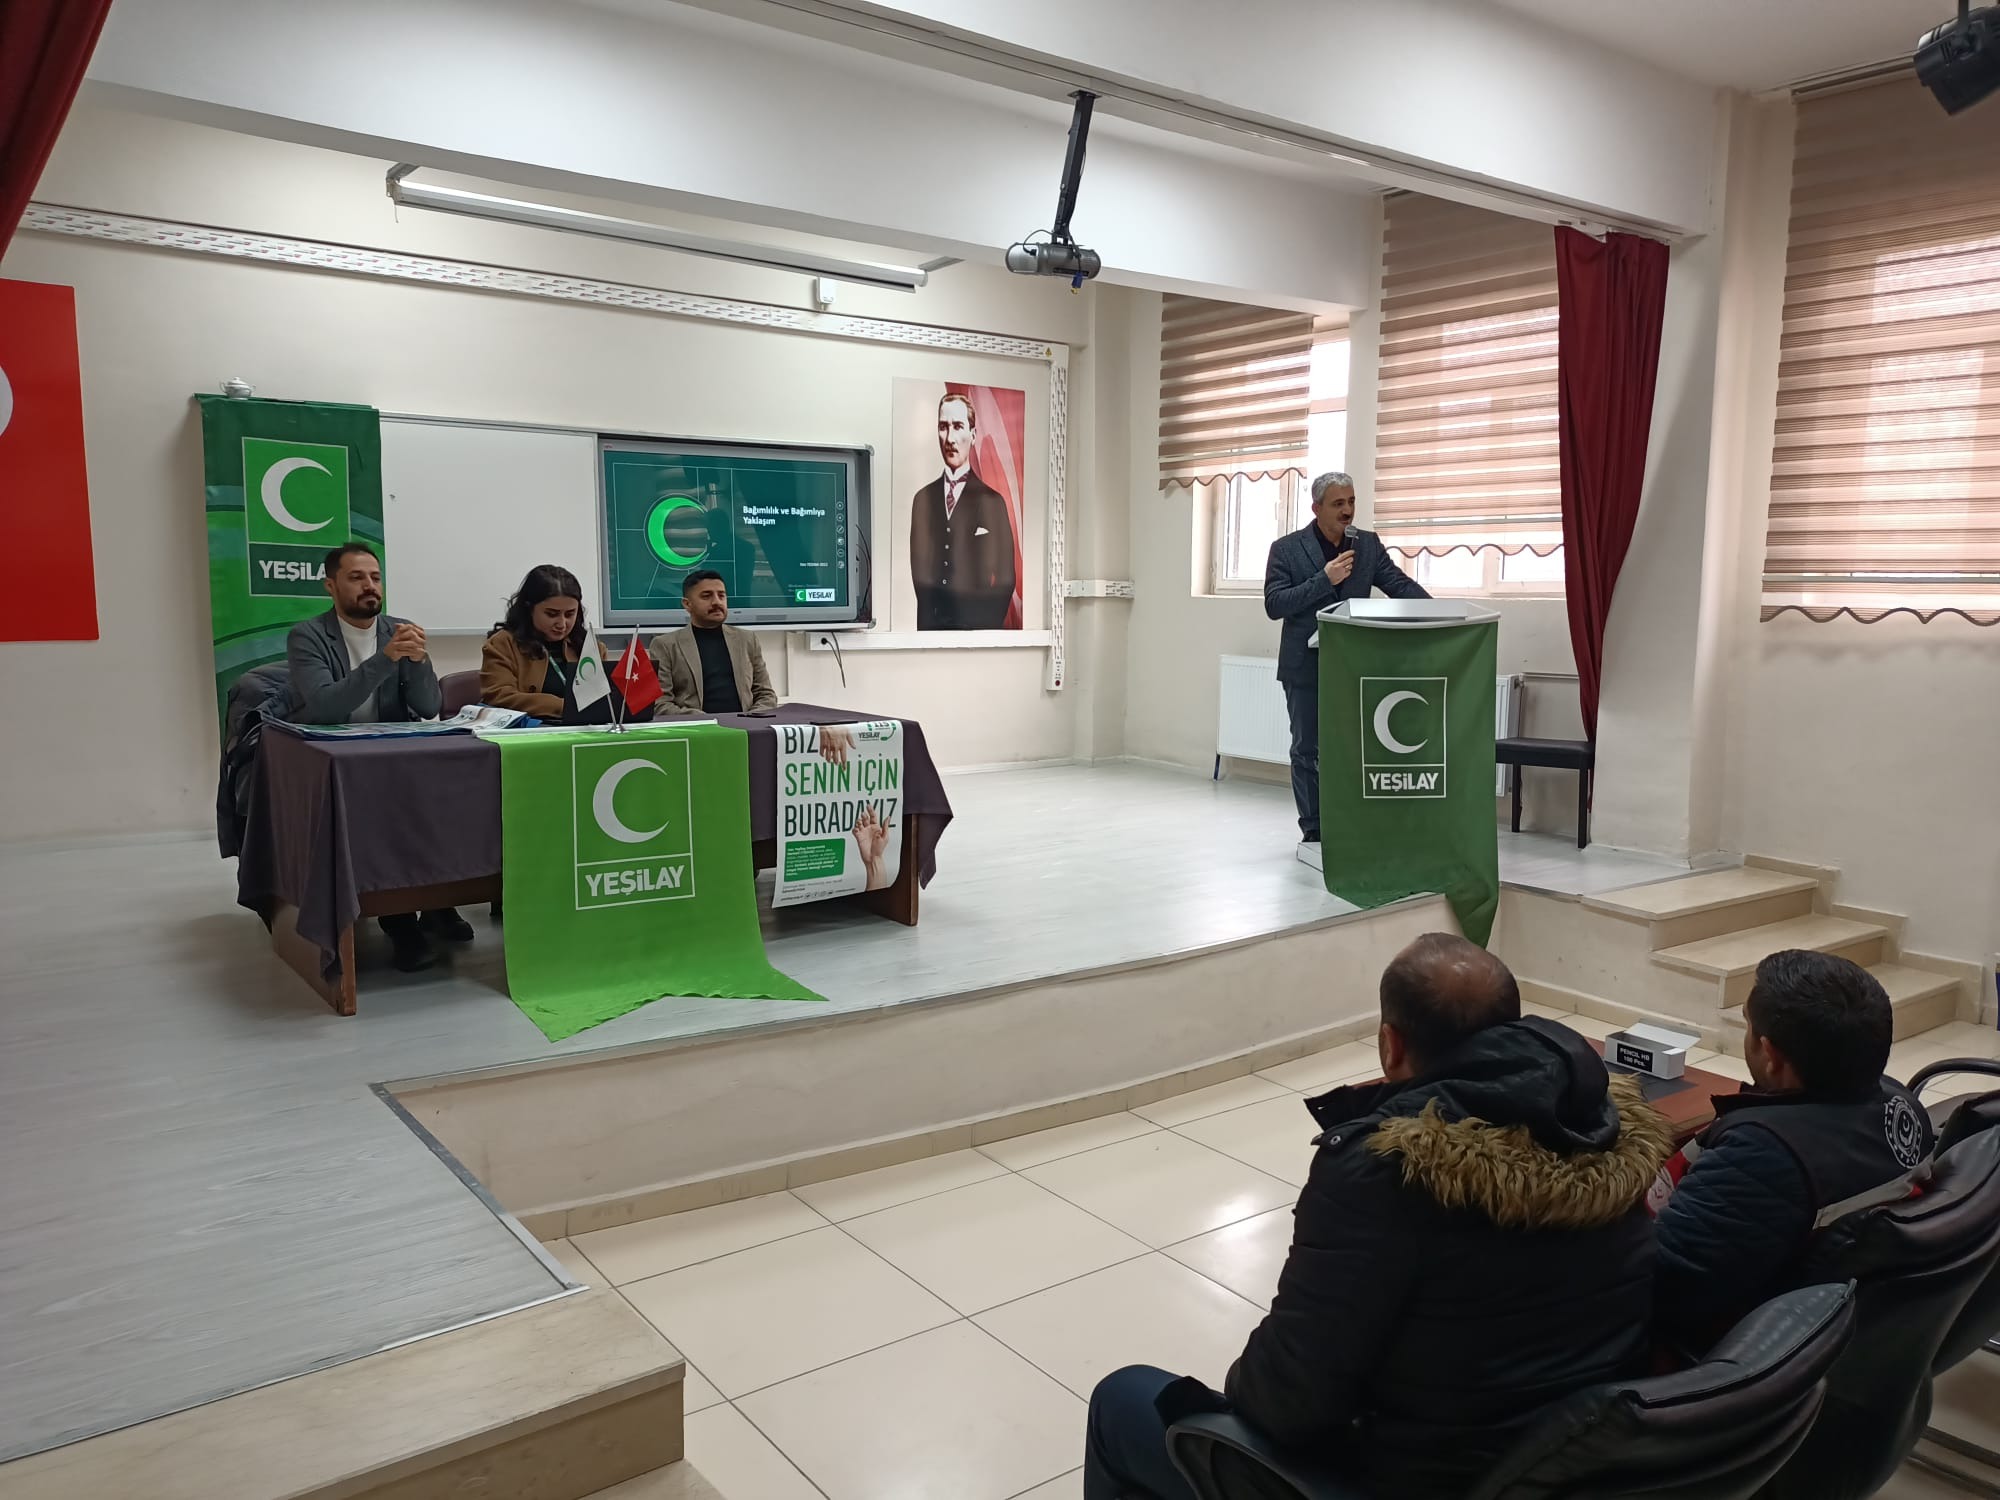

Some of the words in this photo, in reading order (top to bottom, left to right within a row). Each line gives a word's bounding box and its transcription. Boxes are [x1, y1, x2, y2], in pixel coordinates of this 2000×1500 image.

[743, 517, 775, 526] Yaklaşım
[857, 753, 898, 796] İÇİN
[1620, 1047, 1640, 1058] PENCIL
